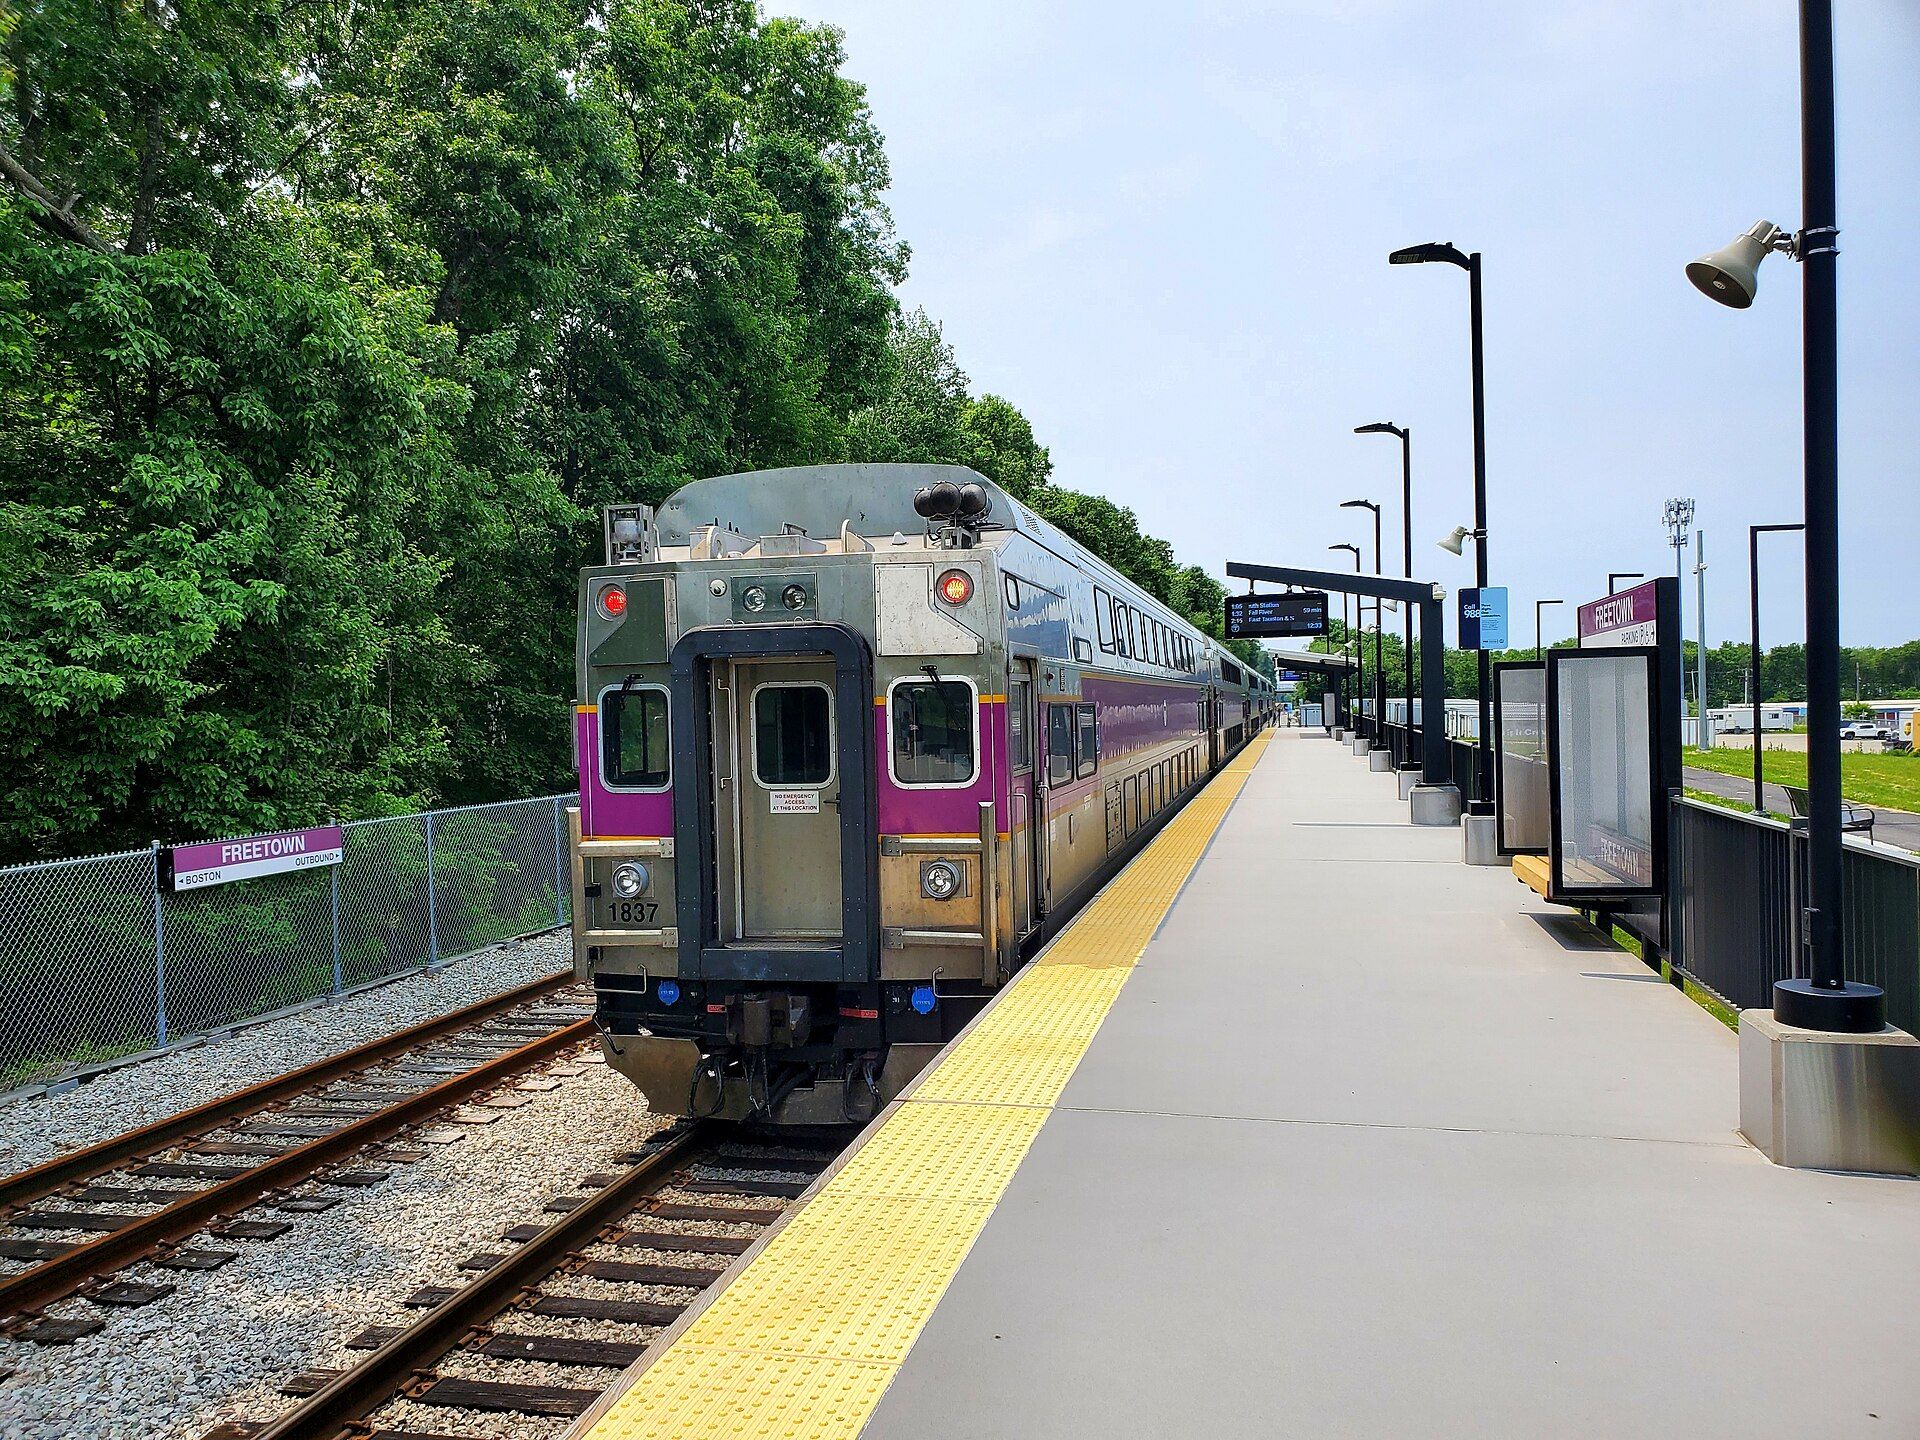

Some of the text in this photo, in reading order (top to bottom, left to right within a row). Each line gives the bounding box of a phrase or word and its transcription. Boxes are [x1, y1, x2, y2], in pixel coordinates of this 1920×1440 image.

[1463, 609, 1480, 618] 988
[1595, 595, 1634, 630] FREETOWN
[1621, 630, 1639, 645] PARKING
[221, 834, 306, 864] FREETOWN
[185, 852, 334, 885] BOSTON OUTBOUND
[608, 902, 659, 923] 1837
